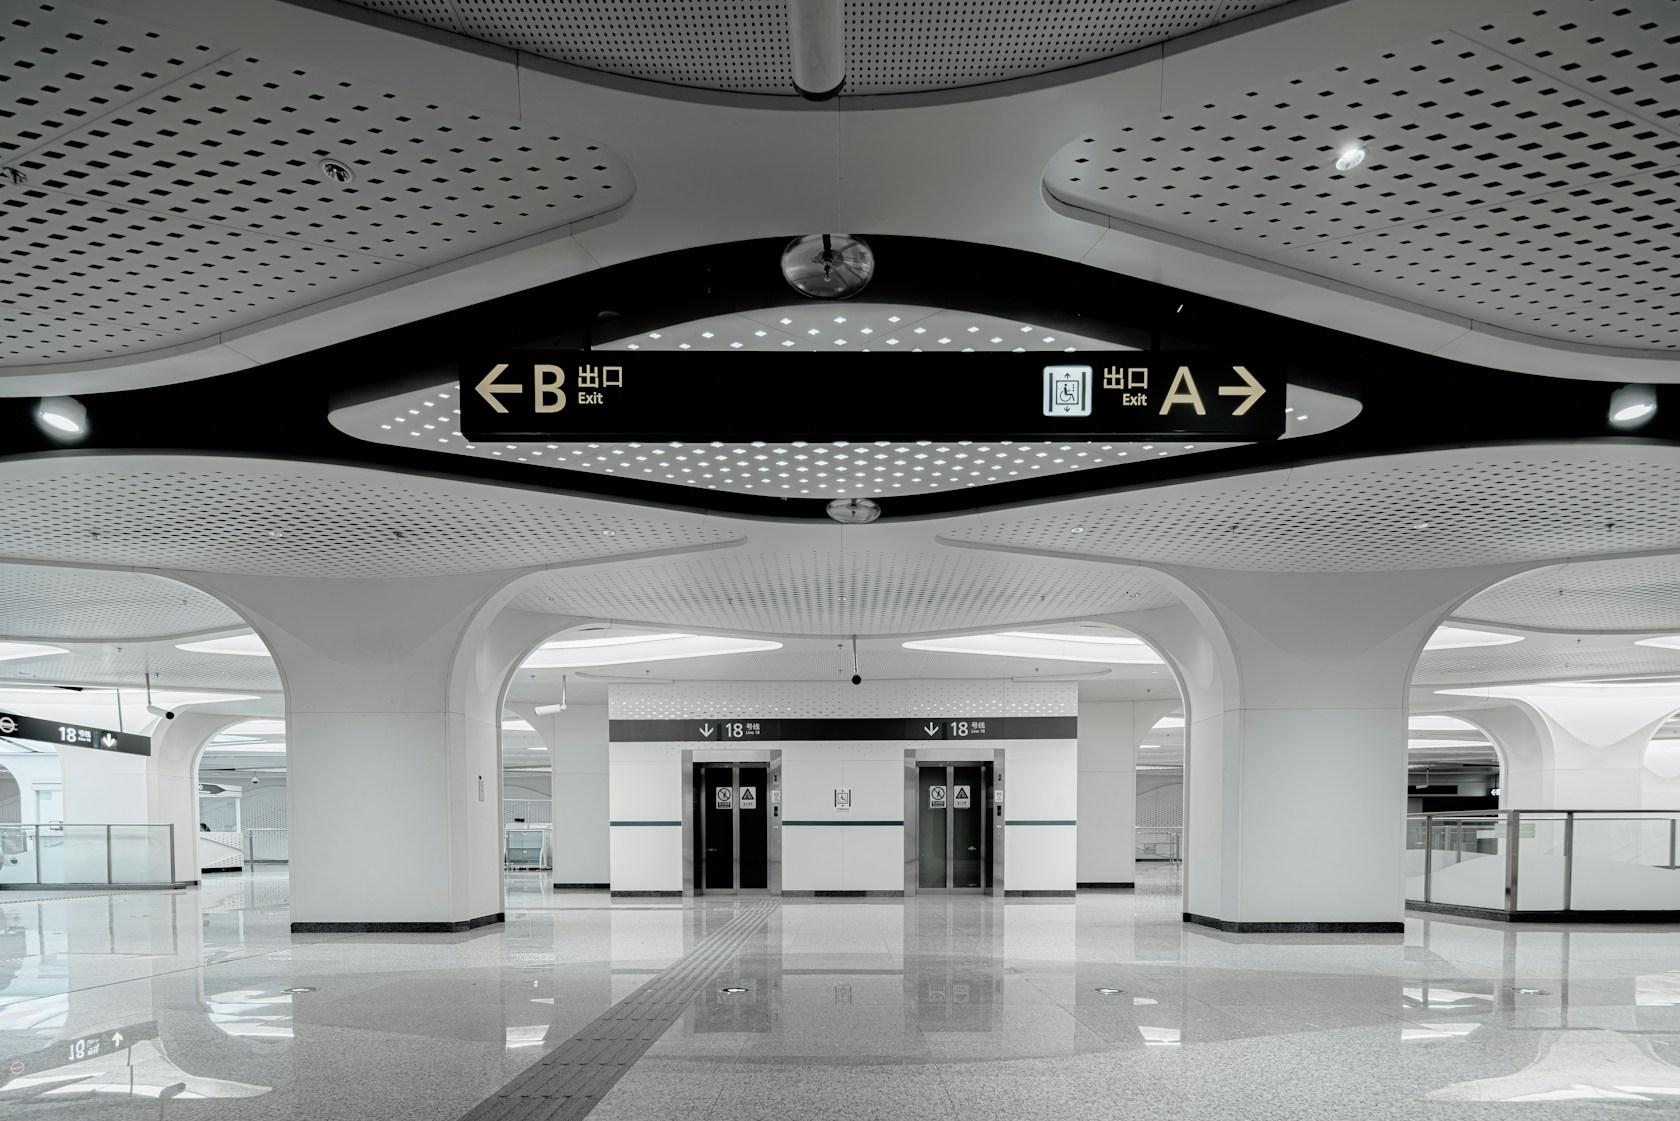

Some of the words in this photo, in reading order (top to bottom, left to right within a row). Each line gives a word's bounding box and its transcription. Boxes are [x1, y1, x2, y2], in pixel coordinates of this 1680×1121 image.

[578, 364, 623, 388] 出口
[1103, 365, 1149, 389] 出口
[534, 364, 567, 413] B
[1159, 365, 1206, 415] A
[578, 392, 603, 405] Exit
[1122, 393, 1148, 406] Exit
[58, 727, 77, 742] 18
[726, 722, 743, 738] 18
[951, 721, 968, 737] 18
